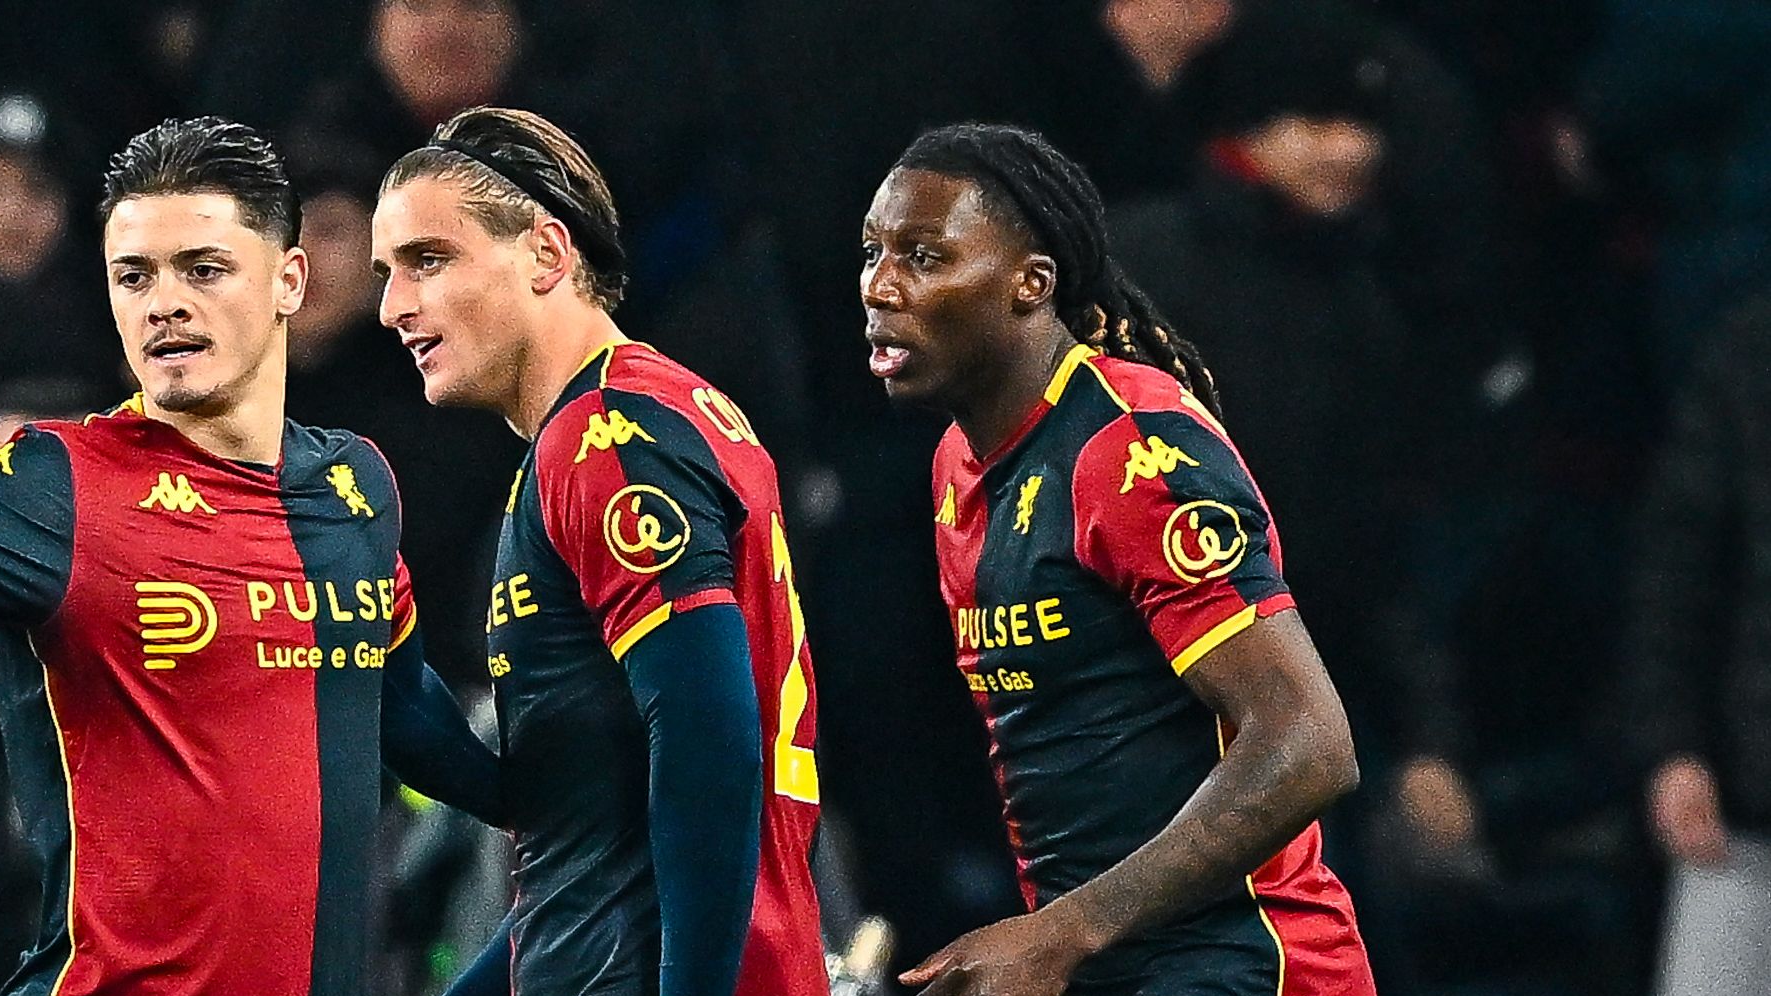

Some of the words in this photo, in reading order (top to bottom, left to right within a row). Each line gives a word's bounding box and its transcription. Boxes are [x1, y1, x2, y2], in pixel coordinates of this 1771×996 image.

[247, 578, 394, 622] PULSE
[486, 573, 539, 633] EE
[957, 597, 1070, 649] PULSEE
[257, 641, 323, 669] Luce
[331, 646, 347, 669] e
[488, 653, 512, 678] as
[997, 667, 1034, 692] Gas
